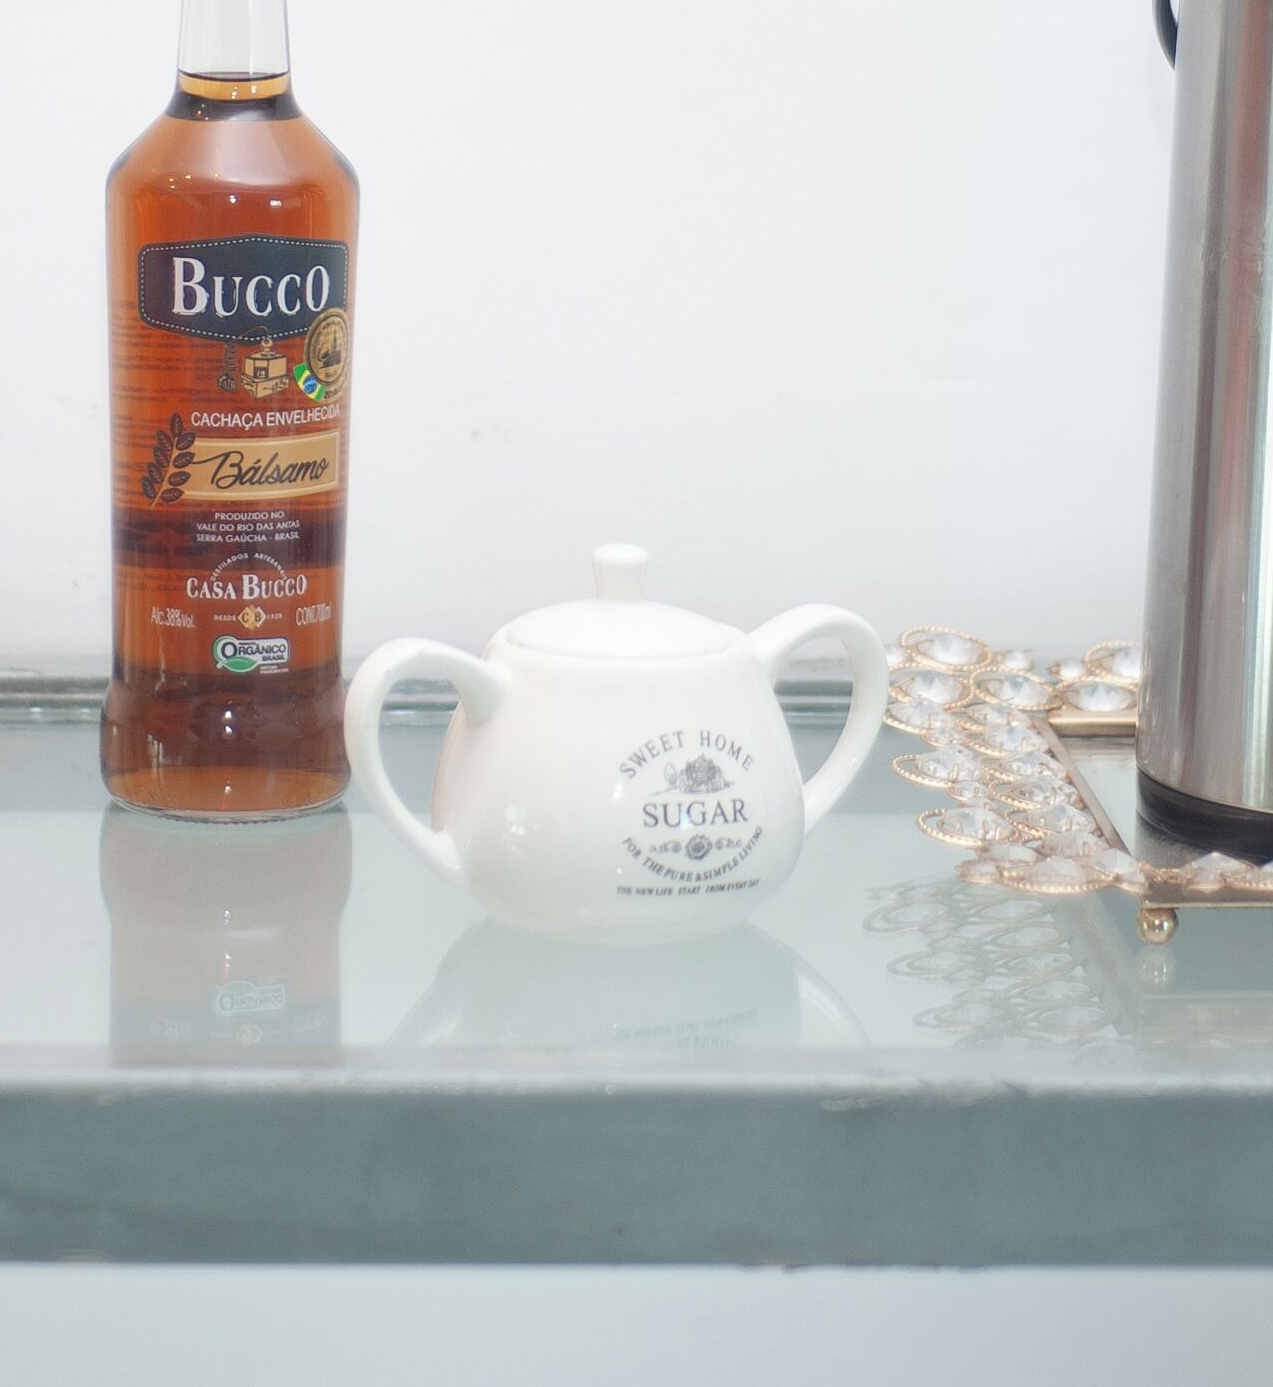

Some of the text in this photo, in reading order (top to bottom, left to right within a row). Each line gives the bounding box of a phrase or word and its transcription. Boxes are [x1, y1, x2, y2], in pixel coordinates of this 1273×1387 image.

[172, 257, 330, 317] BUCCO
[191, 412, 264, 430] CACHAÇA
[193, 450, 329, 489] Bálsamo
[196, 522, 217, 532] VALE
[219, 523, 235, 532] DO
[256, 522, 274, 531] DAS
[270, 510, 285, 519] NO
[196, 533, 223, 543] SERRA
[274, 531, 300, 541] BRASIL
[186, 574, 308, 600] CASA BUCCO
[619, 730, 753, 779] SWEET HOME
[642, 799, 748, 828] SUGAR
[622, 837, 642, 859] FOR
[643, 856, 665, 875] THE
[663, 868, 693, 882] PURE
